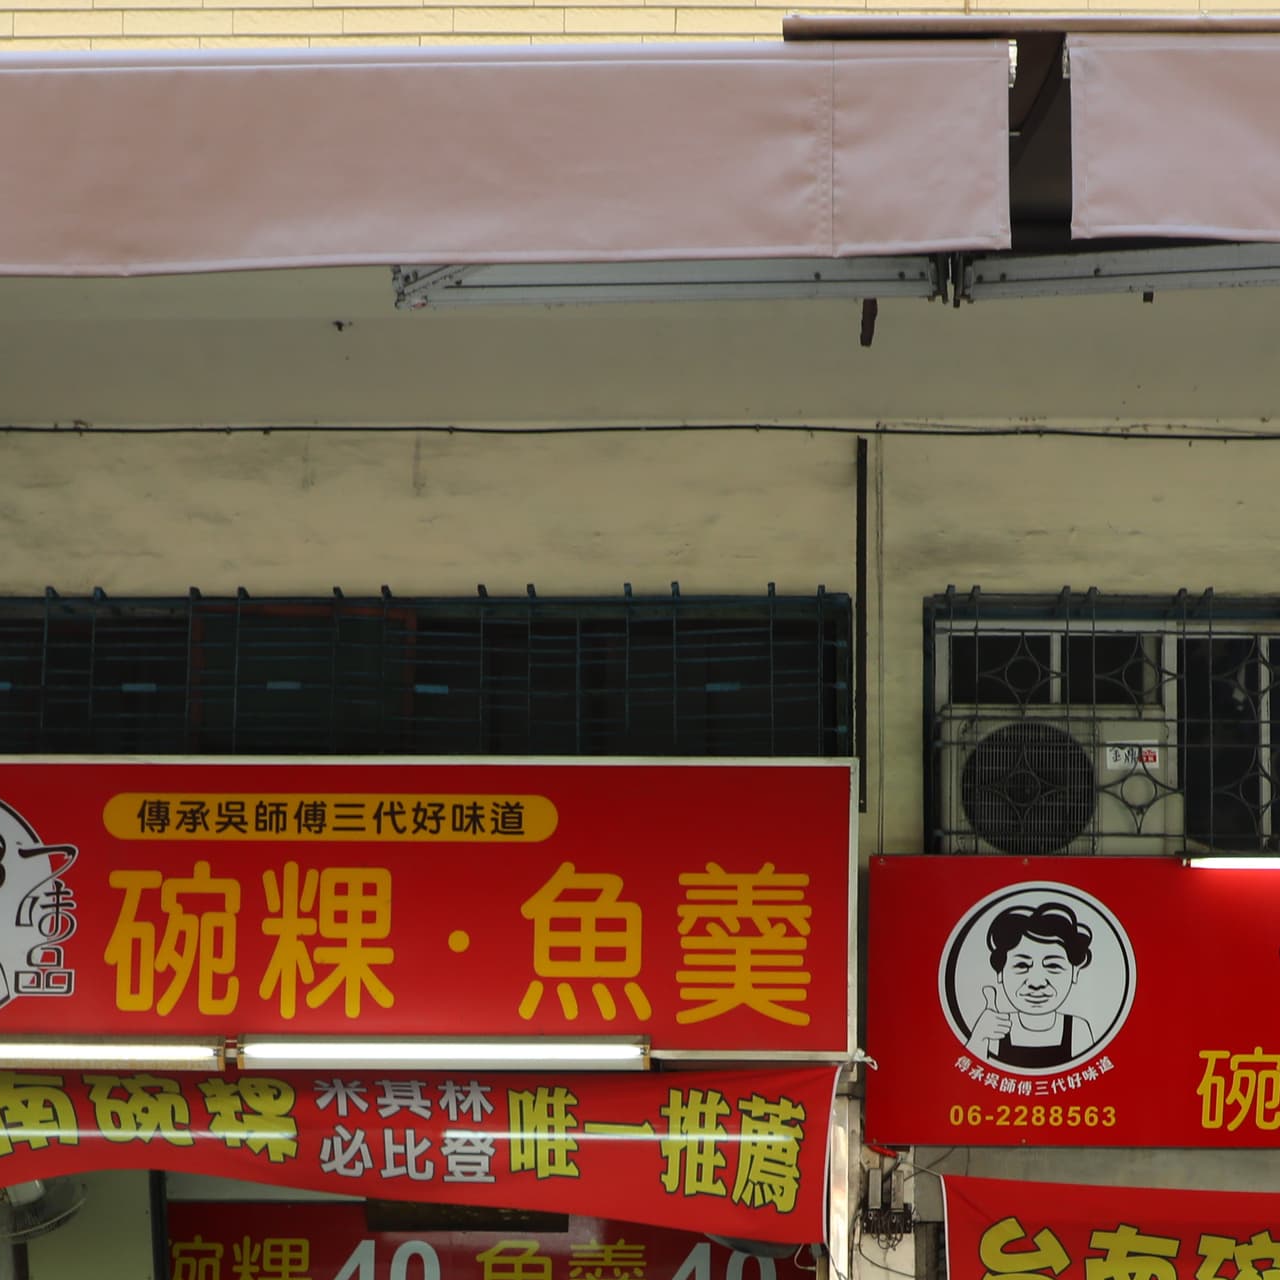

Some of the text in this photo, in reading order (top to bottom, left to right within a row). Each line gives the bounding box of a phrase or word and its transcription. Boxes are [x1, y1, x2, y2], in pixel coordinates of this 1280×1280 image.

[135, 799, 528, 838] 傳承吳師傅三代好味道
[953, 1054, 1116, 1097] 傳承吳師傅三代好味道
[313, 1078, 495, 1123] 米其林
[949, 1104, 1117, 1128] 06-2288563
[319, 1124, 497, 1184] 必比登
[506, 1084, 808, 1217] 唯一推薦
